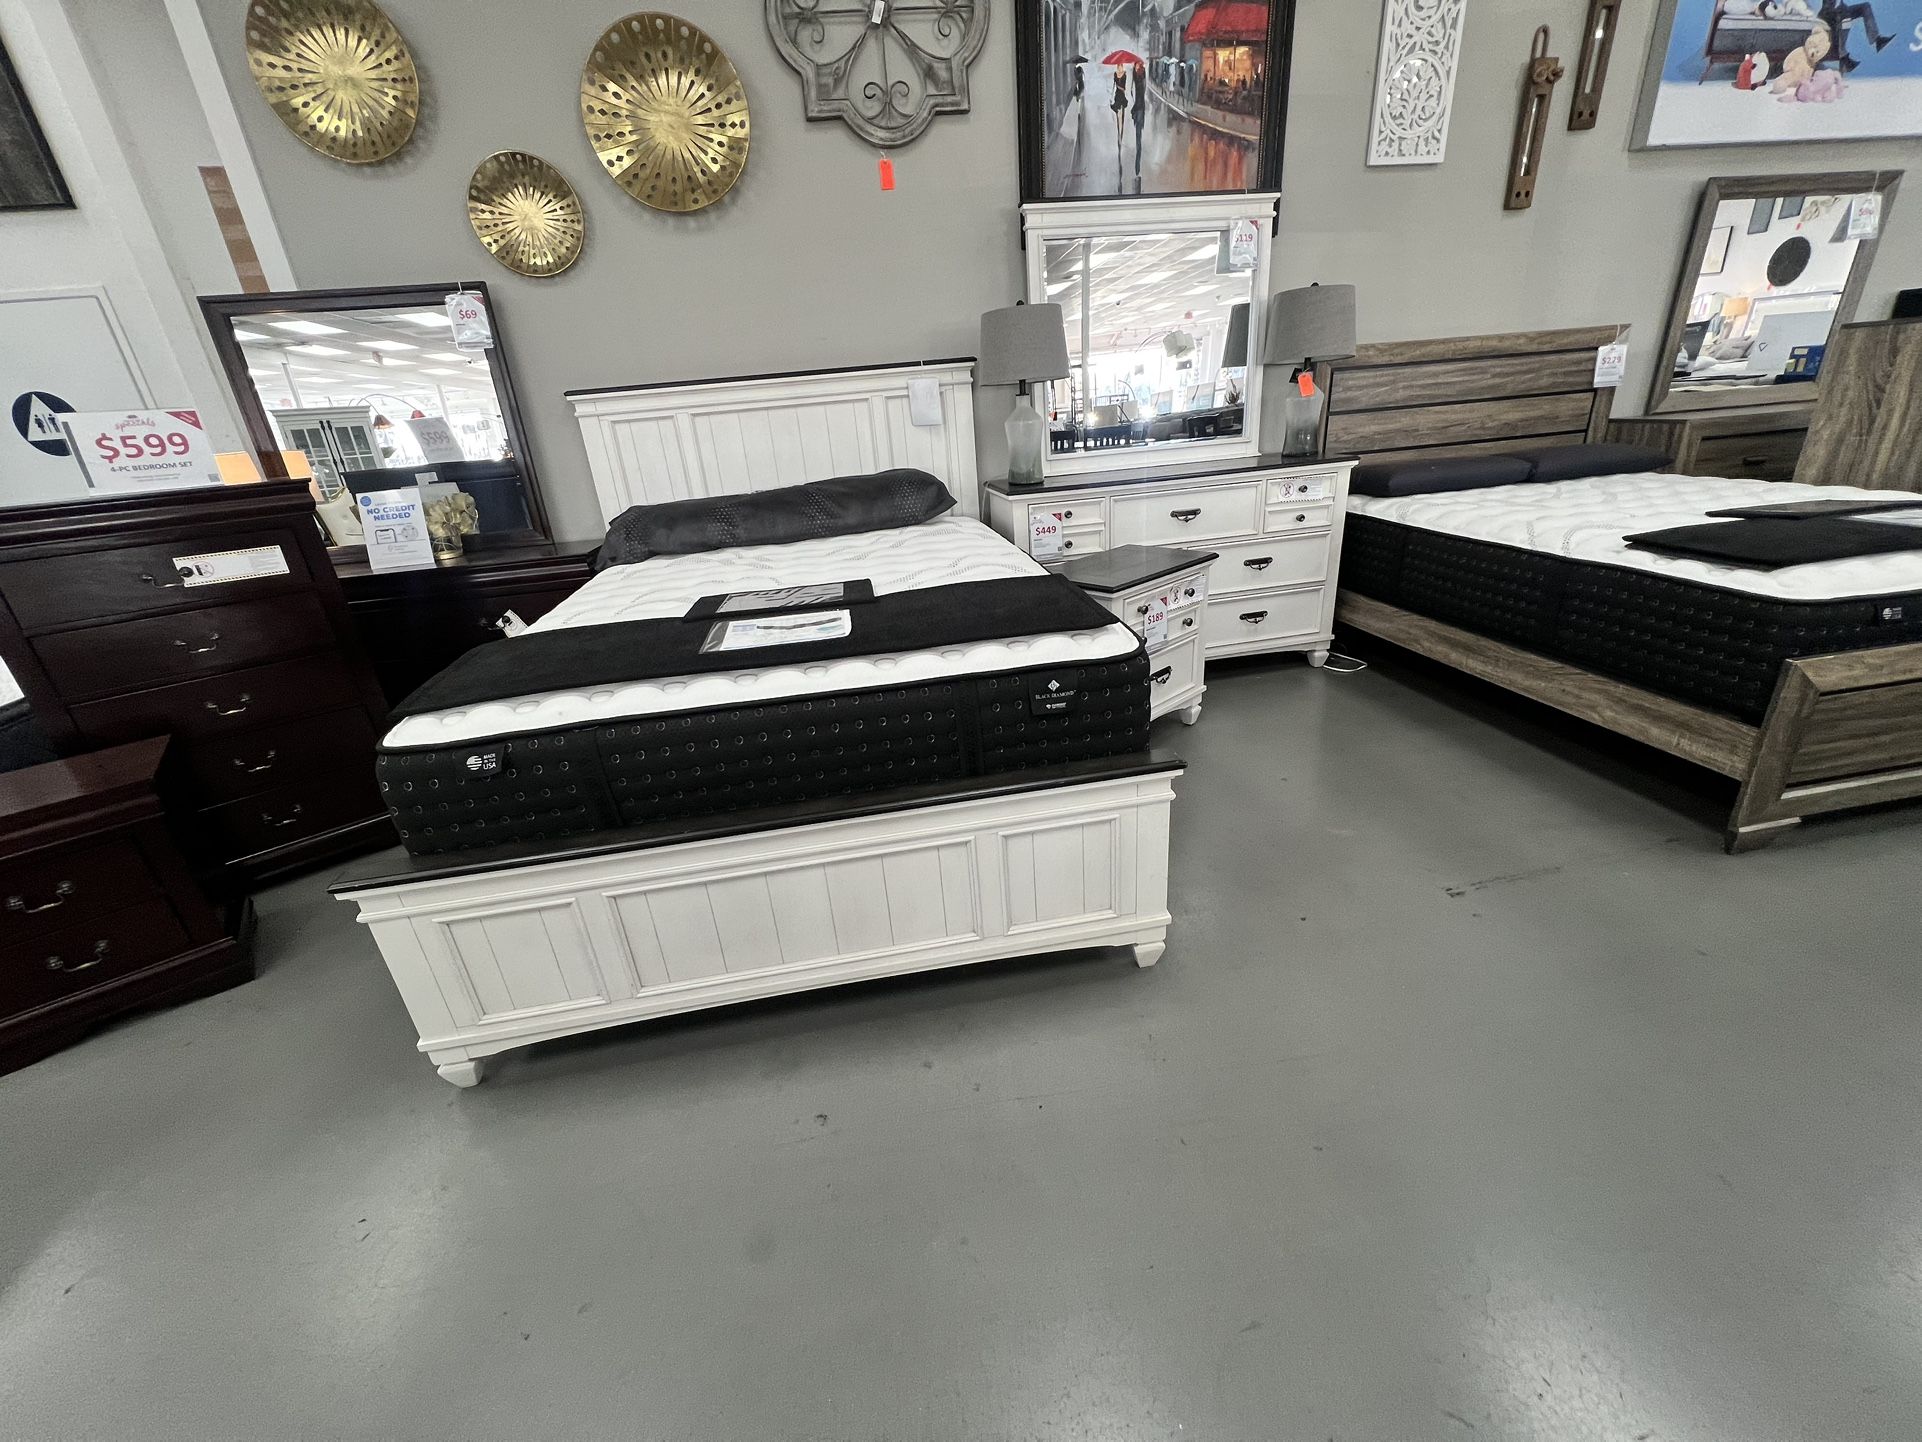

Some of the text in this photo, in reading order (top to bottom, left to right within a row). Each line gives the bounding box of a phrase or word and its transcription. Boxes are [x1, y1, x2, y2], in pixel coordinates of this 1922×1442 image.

[458, 309, 477, 320] $69
[95, 432, 190, 464] $599
[110, 464, 131, 473] 4-PC
[132, 462, 177, 471] BEDROOM
[366, 507, 380, 515] NO
[382, 503, 416, 513] CREDIT
[373, 511, 411, 521] NEEDED
[1035, 525, 1057, 536] $449
[1147, 611, 1164, 625] $189
